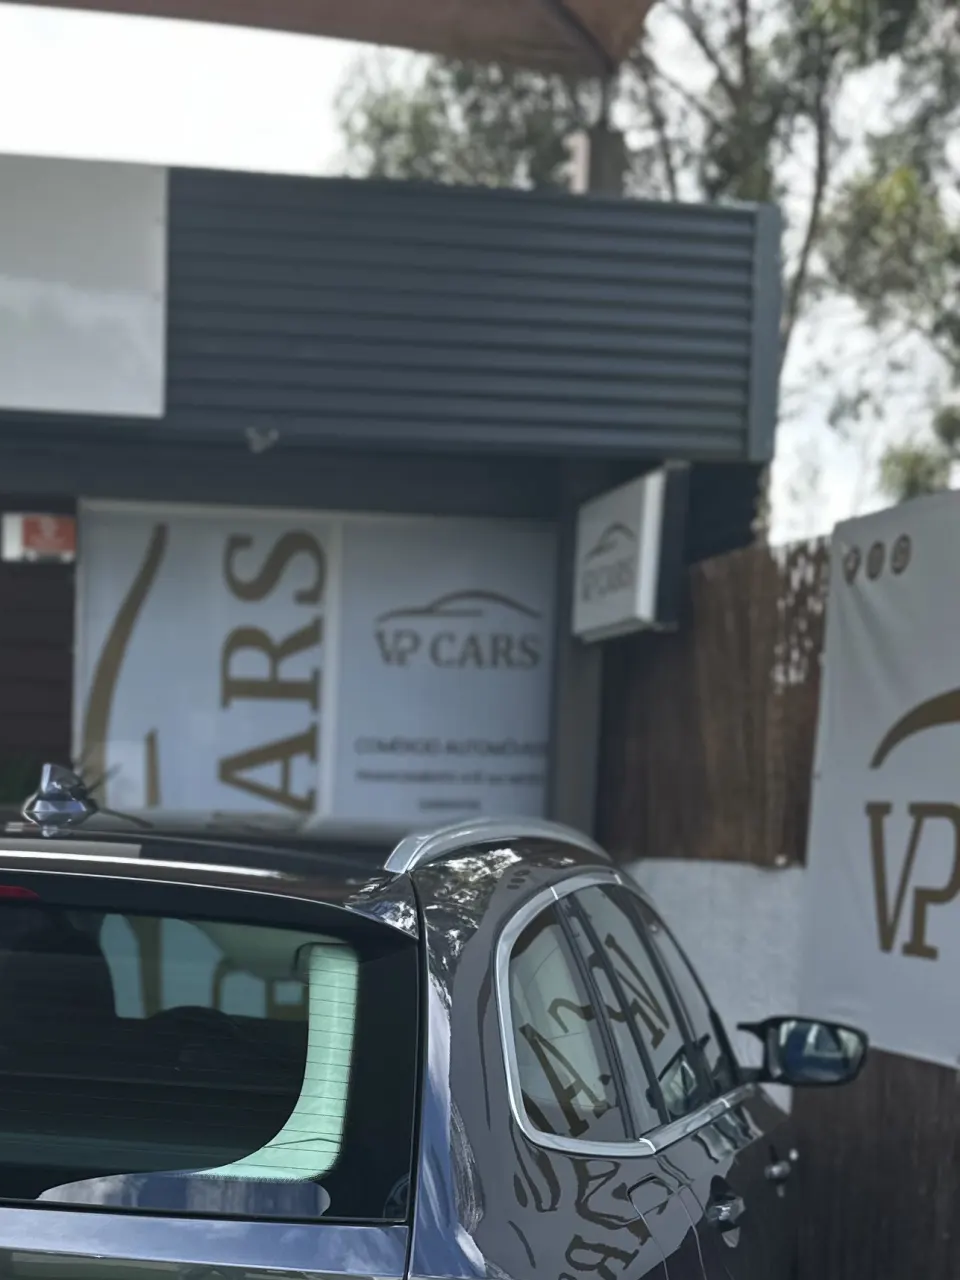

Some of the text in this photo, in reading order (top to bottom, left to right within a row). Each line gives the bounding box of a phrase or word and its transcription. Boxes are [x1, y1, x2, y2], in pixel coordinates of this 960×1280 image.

[217, 528, 328, 815] ARS
[374, 628, 542, 670] VP CARS
[865, 801, 960, 961] VP
